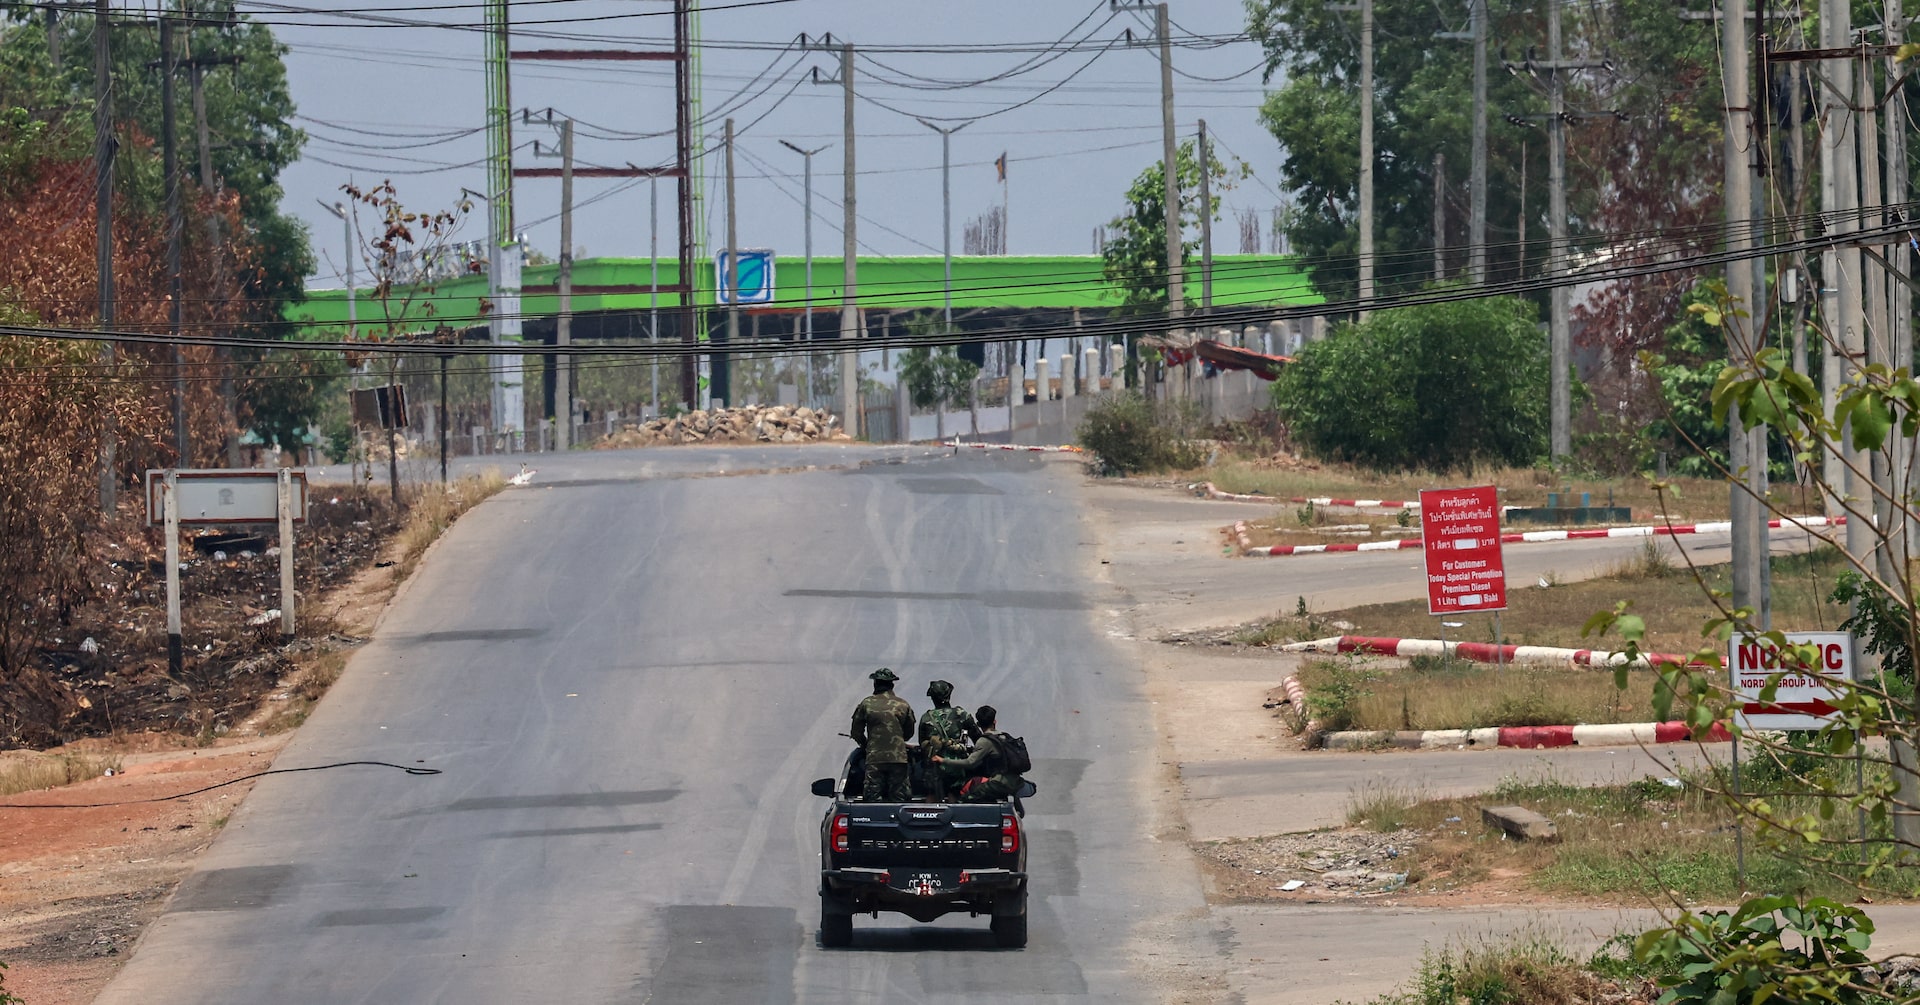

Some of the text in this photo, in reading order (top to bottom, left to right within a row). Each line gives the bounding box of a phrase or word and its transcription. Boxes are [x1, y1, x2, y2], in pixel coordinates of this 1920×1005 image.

[1481, 537, 1495, 547] บาท
[1442, 560, 1486, 570] For Customers
[1429, 570, 1503, 583] Today Special Promotion
[1442, 582, 1491, 594] Premium Diesel
[1443, 596, 1457, 605] Litre
[1777, 678, 1806, 688] GROUP
[861, 839, 989, 850] REVOLUTION
